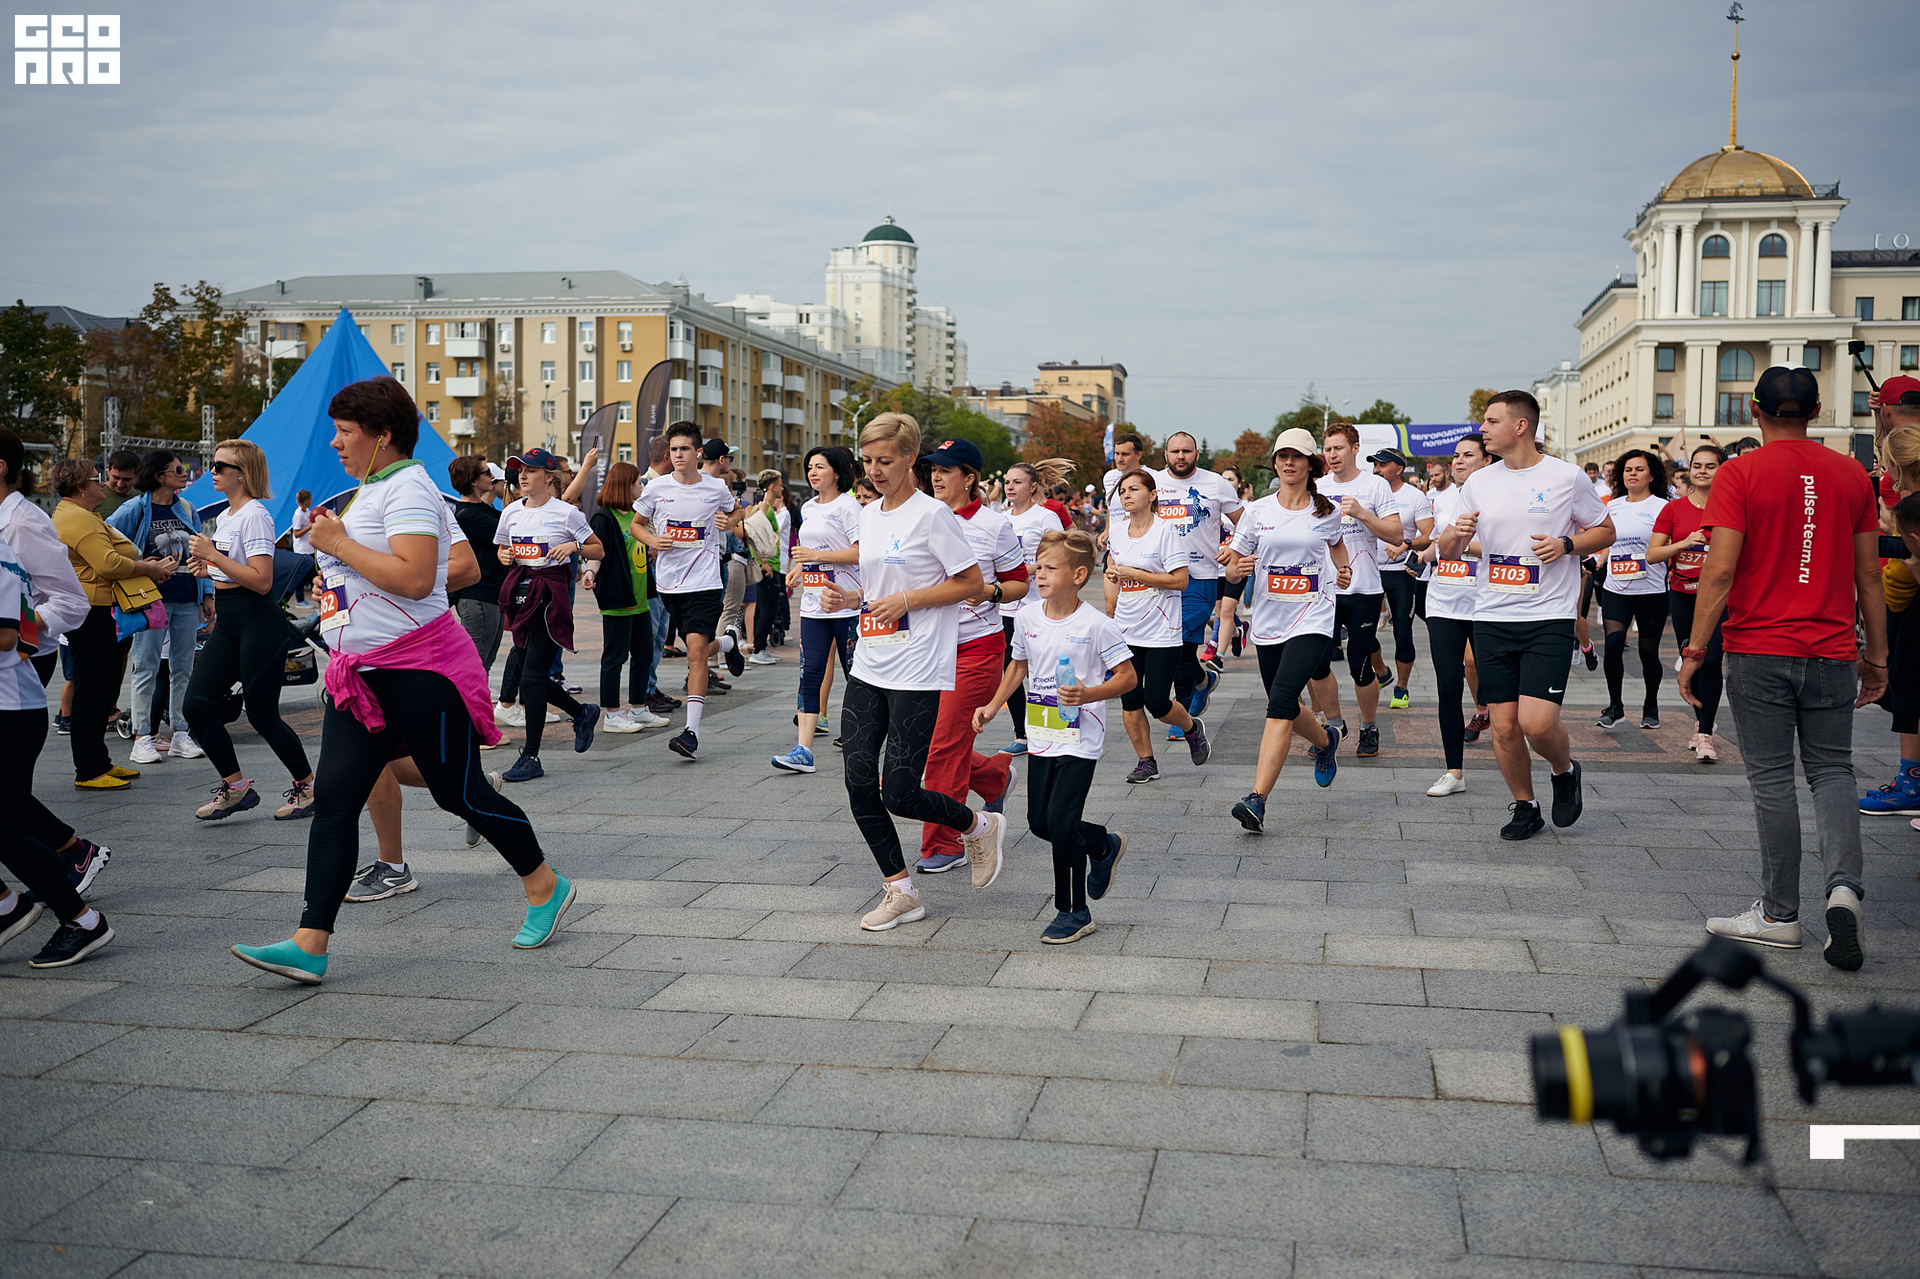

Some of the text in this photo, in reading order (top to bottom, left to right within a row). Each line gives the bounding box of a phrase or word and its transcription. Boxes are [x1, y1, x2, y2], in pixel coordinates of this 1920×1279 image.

[1159, 506, 1186, 517] 5000
[669, 528, 697, 540] 5152
[1798, 475, 1819, 584] pulse-team.ru
[515, 545, 539, 556] 5059
[1678, 552, 1708, 564] 5371
[1439, 562, 1466, 574] 5104
[1613, 562, 1637, 572] 5372
[804, 573, 825, 584] 5031
[1491, 567, 1527, 581] 5103
[1271, 577, 1308, 590] 5175
[321, 593, 335, 615] 62
[1041, 707, 1049, 727] 1
